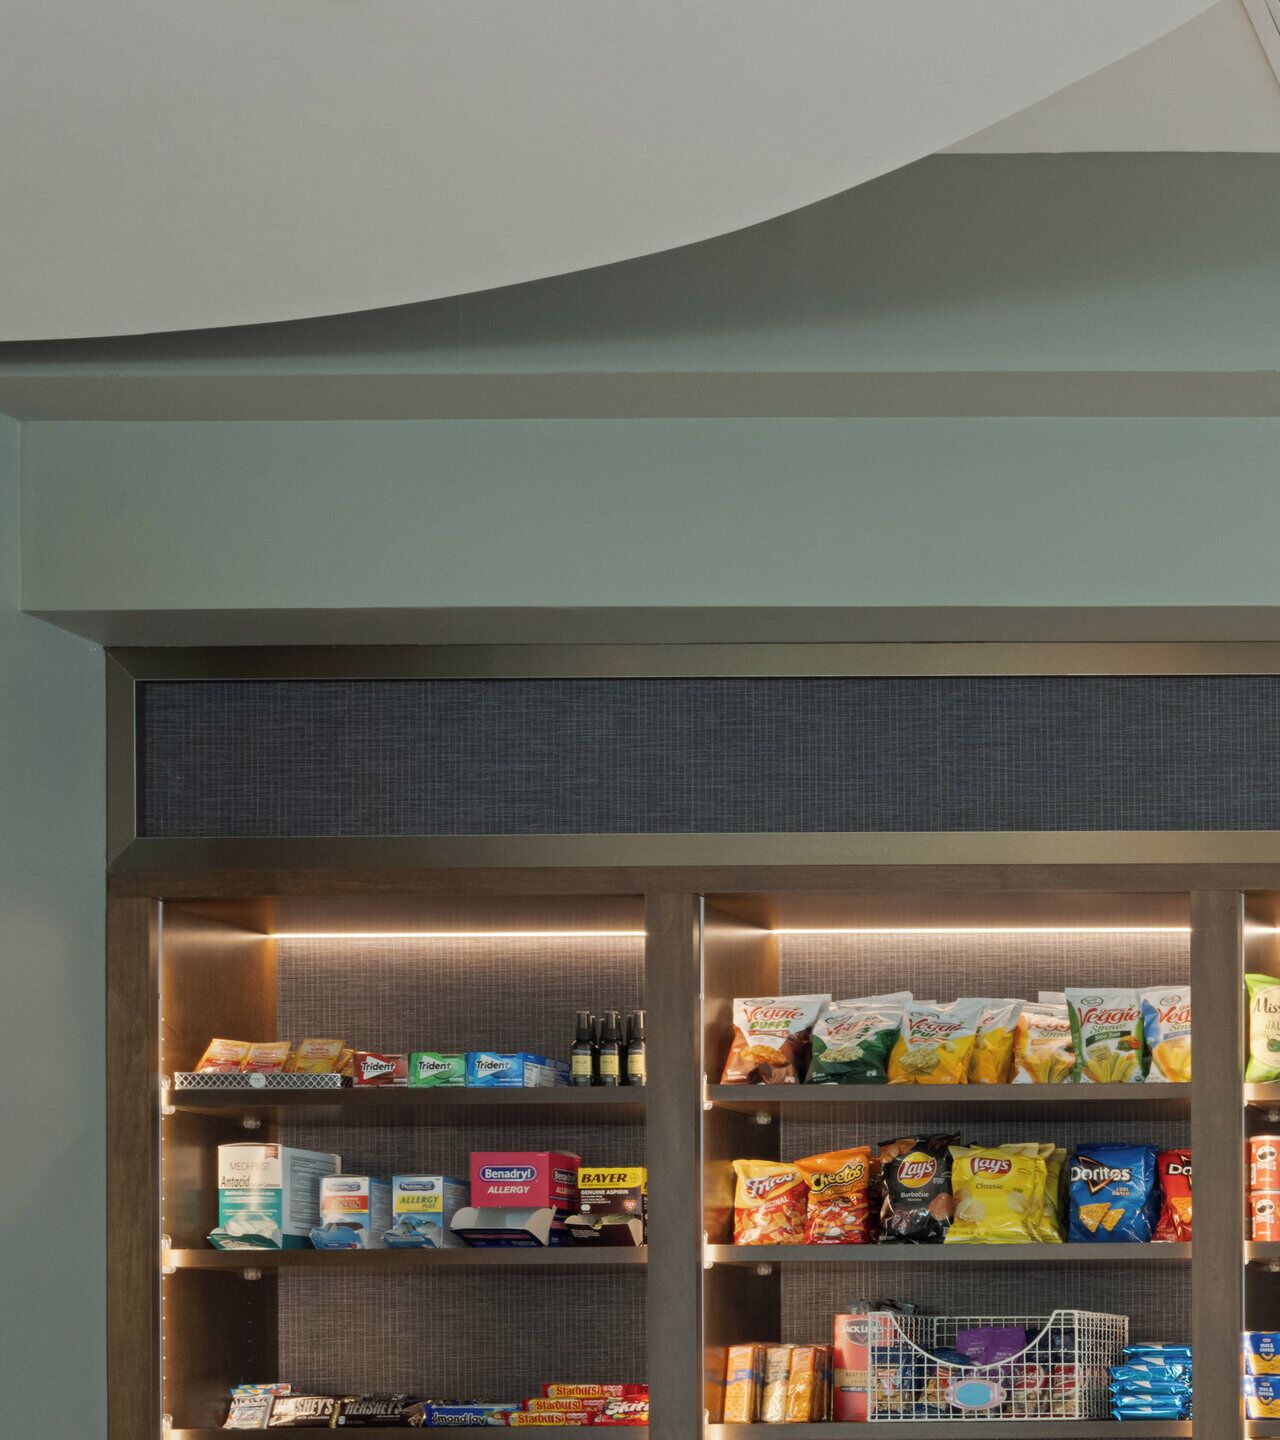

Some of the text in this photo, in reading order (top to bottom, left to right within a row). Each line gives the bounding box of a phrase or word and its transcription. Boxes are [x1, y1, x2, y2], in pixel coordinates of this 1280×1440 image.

[743, 1006, 806, 1023] Veggie
[1078, 1004, 1141, 1028] Veggie
[361, 1061, 395, 1072] Trident
[418, 1060, 450, 1071] Trident
[476, 1059, 510, 1070] Trident
[901, 1159, 934, 1179] Lay's
[973, 1157, 1011, 1174] Lay's
[485, 1168, 531, 1182] Benadryl
[581, 1173, 628, 1183] BAYER
[811, 1163, 864, 1190] Cheetos
[1070, 1165, 1131, 1182] Doritos
[221, 1175, 251, 1188] Antacid
[976, 1182, 1004, 1190] Classic
[487, 1185, 530, 1194] ALLERGY
[399, 1195, 439, 1204] ALLERGY
